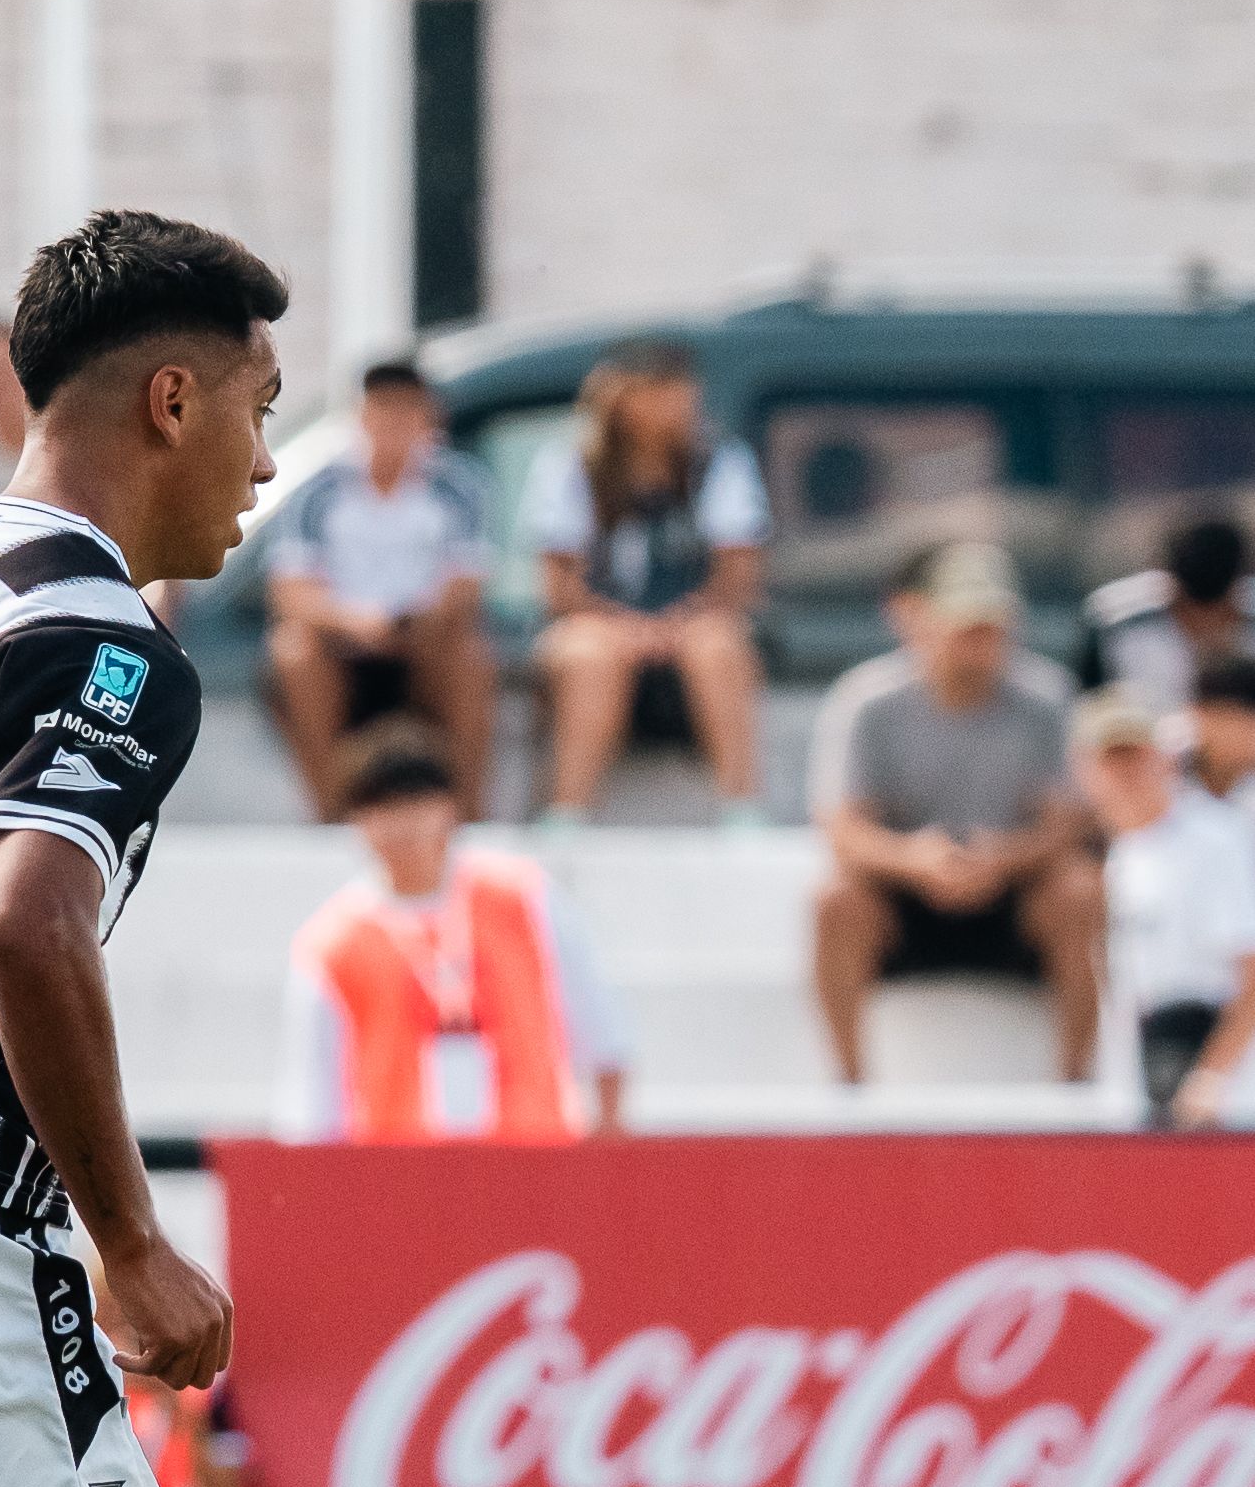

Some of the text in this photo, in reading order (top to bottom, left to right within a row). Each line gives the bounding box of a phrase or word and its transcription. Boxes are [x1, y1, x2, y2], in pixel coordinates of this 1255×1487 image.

[84, 683, 131, 719] LPF
[61, 712, 158, 765] Montemar
[49, 1278, 90, 1395] 1908
